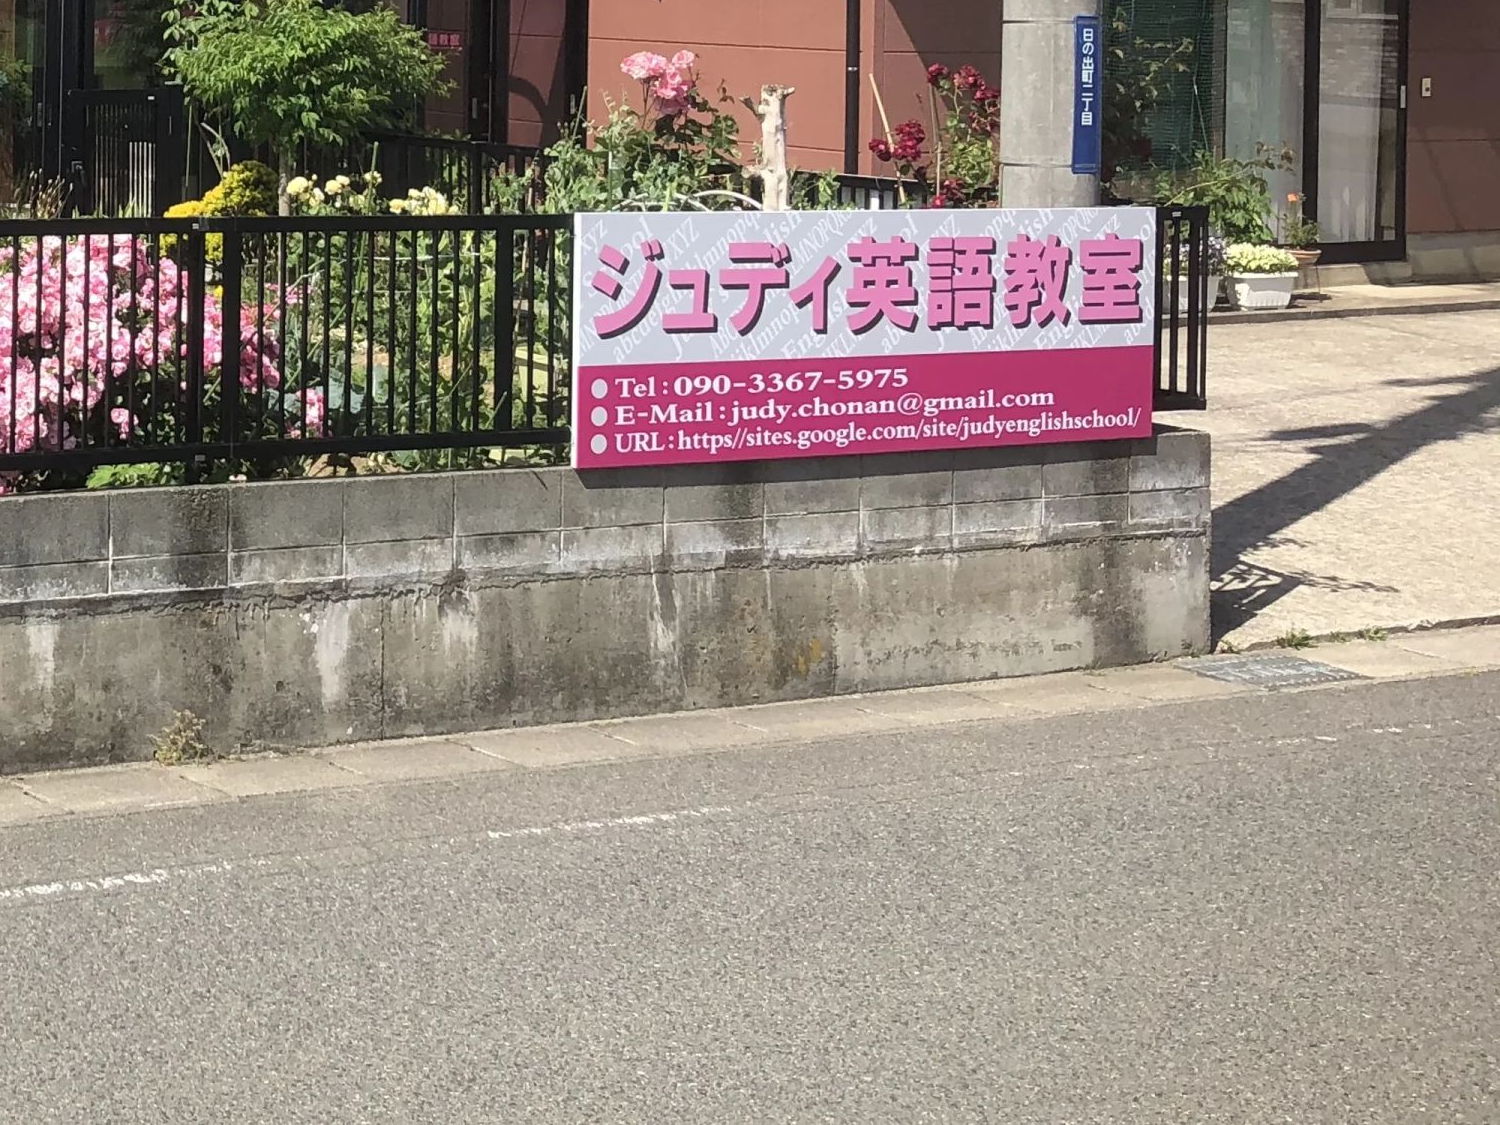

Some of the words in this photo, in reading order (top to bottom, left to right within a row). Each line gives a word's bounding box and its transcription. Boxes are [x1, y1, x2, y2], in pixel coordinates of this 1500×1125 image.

[1081, 28, 1094, 125] 日の出町二丁目
[591, 233, 1143, 340] ジュディ英語教室
